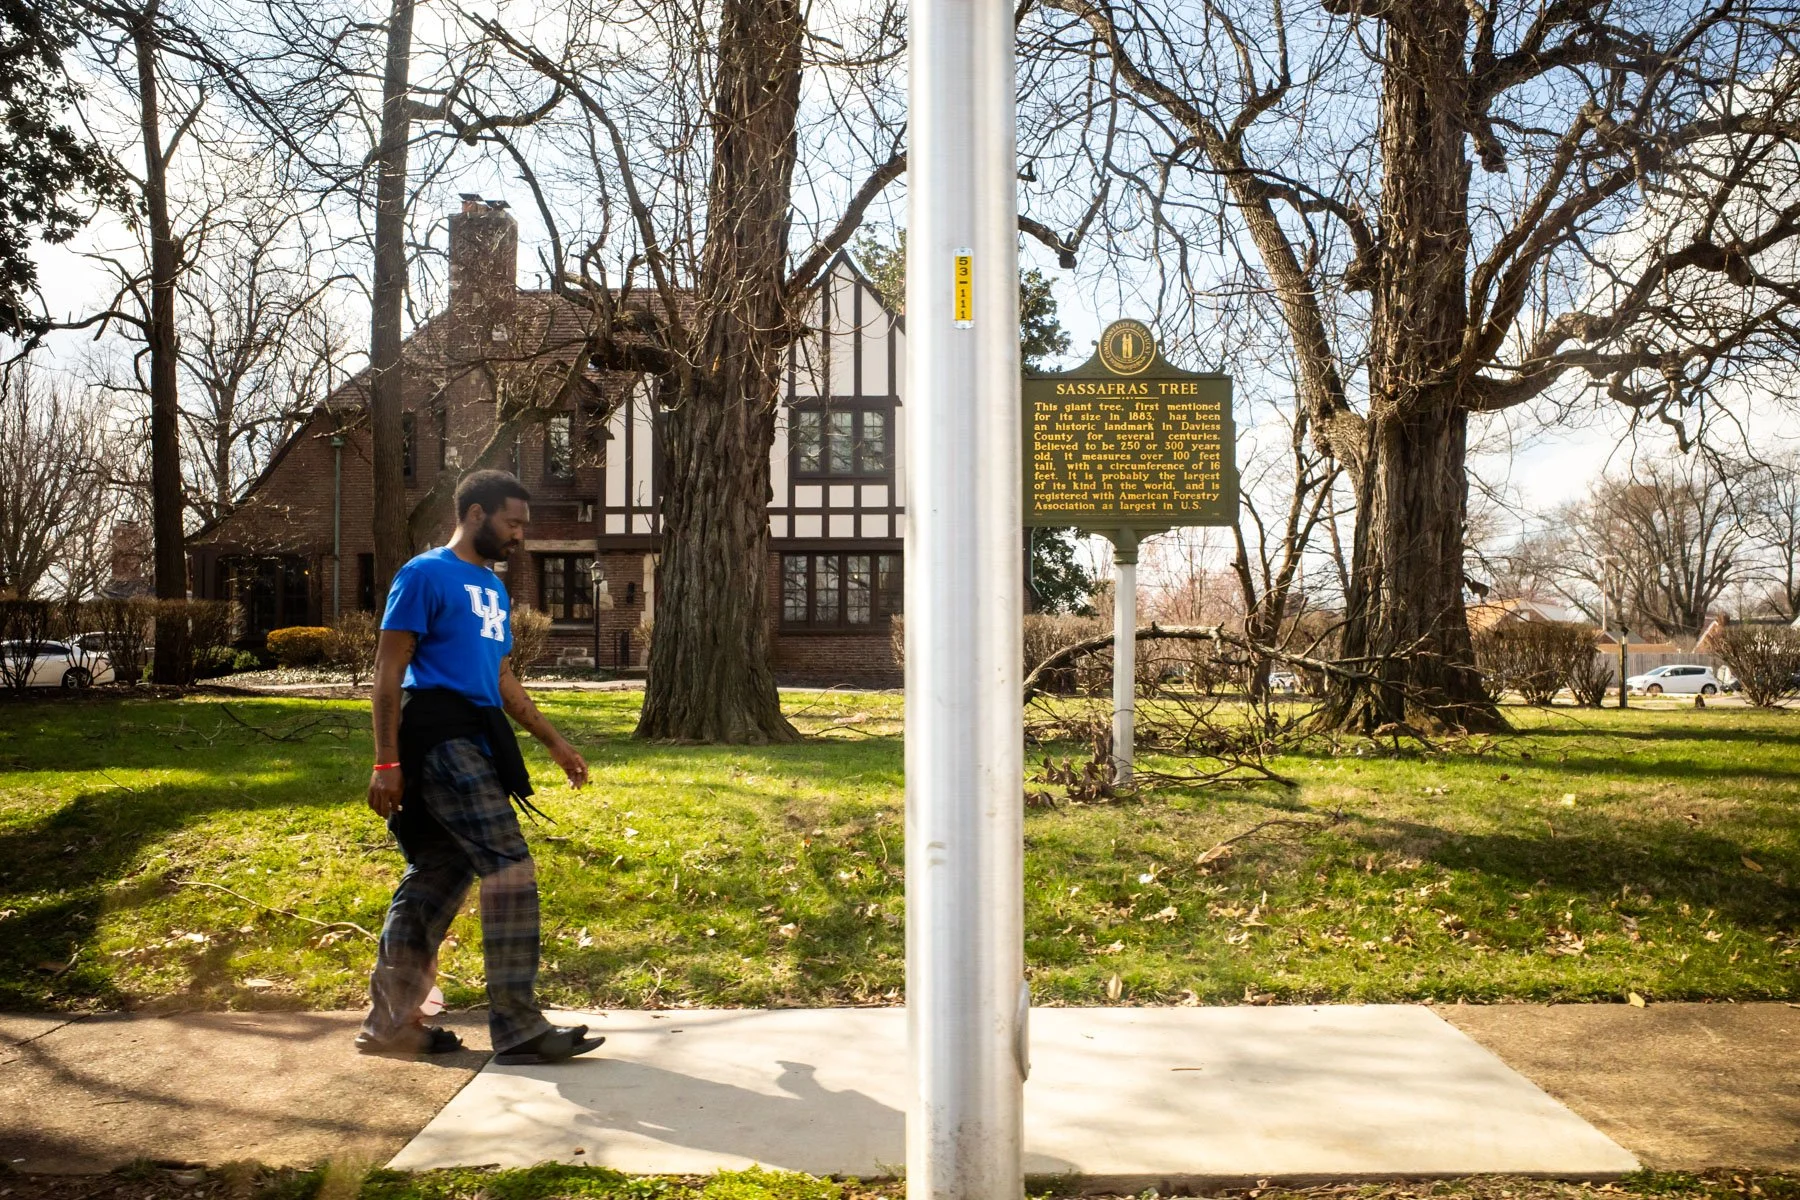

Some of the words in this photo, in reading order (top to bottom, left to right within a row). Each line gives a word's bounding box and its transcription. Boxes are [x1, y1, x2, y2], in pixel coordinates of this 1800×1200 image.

[958, 256, 969, 319] 53-111
[1056, 383, 1148, 394] SASSAFRAS
[1158, 383, 1198, 394] TREE
[1034, 402, 1058, 411] This
[1064, 403, 1092, 413] giant
[1135, 403, 1159, 411] first
[1167, 403, 1220, 411] mentioned
[1034, 412, 1051, 420] for
[1060, 412, 1073, 420] its
[1081, 412, 1101, 420] size
[1110, 412, 1120, 420] in
[1169, 412, 1187, 420] has
[1196, 412, 1220, 420] been
[1055, 422, 1096, 430] historic
[1104, 422, 1154, 430] landmark
[1162, 422, 1172, 430] in
[1181, 421, 1221, 430] Daviess
[1034, 431, 1074, 442] County
[1087, 432, 1103, 440] for
[1116, 432, 1154, 440] several
[1168, 432, 1220, 440] centuries.
[1034, 441, 1078, 450] Believed
[1085, 442, 1096, 450] to
[1102, 442, 1115, 450] be
[1121, 441, 1140, 450] 250
[1165, 441, 1184, 450] 300
[1192, 444, 1220, 452] years
[1064, 452, 1073, 460] it
[1173, 451, 1190, 460] 100
[1199, 452, 1220, 460] feet
[1067, 462, 1089, 470] with
[1110, 462, 1184, 470] circumference
[1192, 462, 1204, 470] of
[1210, 461, 1220, 470] 16
[1034, 472, 1058, 480] feet.
[1068, 470, 1077, 480] It
[1085, 472, 1093, 480] is
[1102, 472, 1149, 482] probably
[1159, 472, 1176, 480] the
[1184, 472, 1220, 482] largest
[1034, 482, 1046, 490] of
[1053, 482, 1066, 490] its
[1073, 482, 1096, 490] kind
[1103, 482, 1113, 490] in
[1120, 482, 1137, 490] the
[1185, 482, 1204, 490] and
[1212, 482, 1220, 490] is
[1034, 491, 1088, 502] registered
[1092, 491, 1114, 500] with
[1119, 490, 1168, 500] American
[1173, 490, 1220, 502] Forestry
[1034, 500, 1095, 510] Association
[1120, 502, 1156, 512] largest
[1163, 502, 1173, 510] in
[1181, 500, 1201, 510] U.S.
[463, 584, 507, 642] UK
